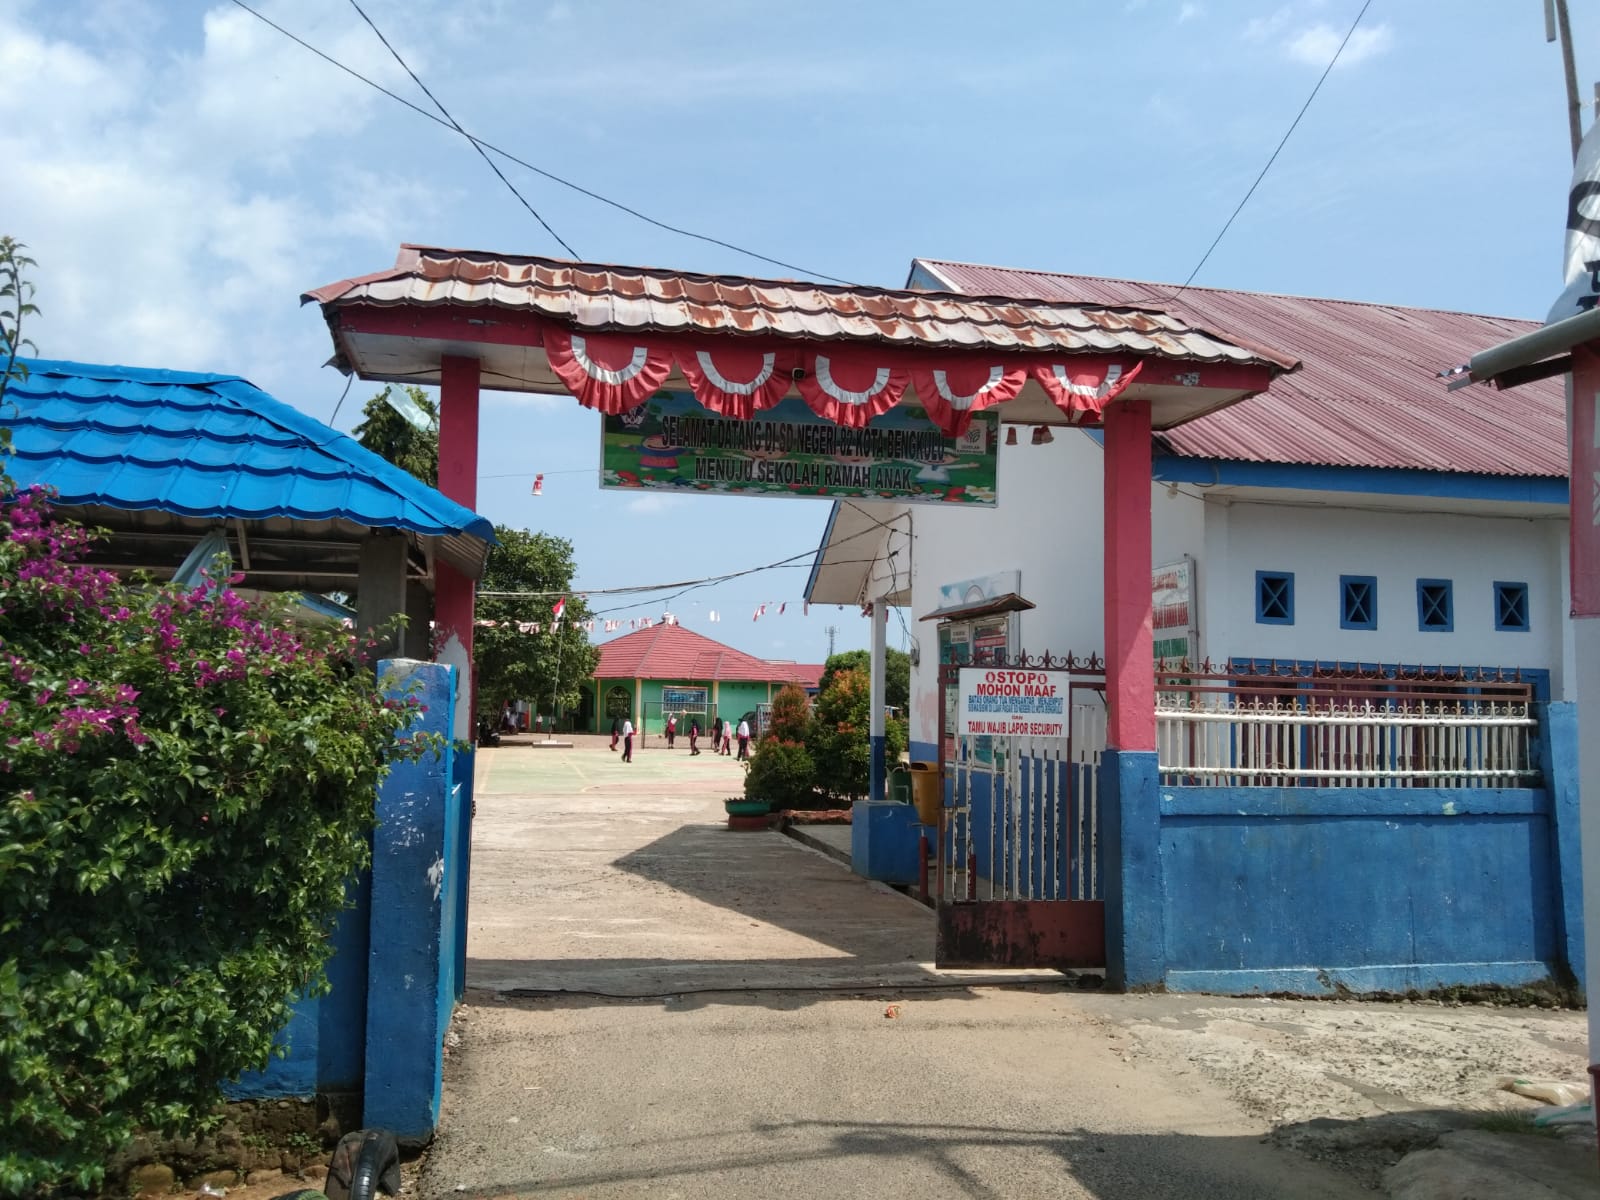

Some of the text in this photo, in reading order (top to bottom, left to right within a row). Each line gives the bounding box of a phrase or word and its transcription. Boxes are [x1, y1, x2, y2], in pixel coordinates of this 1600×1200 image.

[662, 416, 945, 461] SELAMAT DATANG DI SD NEGERI 82 KOTA BENGKULU
[695, 457, 913, 491] MENUJU SEKOLAH RAMAH ANAK
[977, 683, 1056, 697] MOHON MAAF
[968, 721, 985, 733] TAMU
[987, 721, 1006, 733] WAJIB
[1008, 722, 1029, 734] LAPOR
